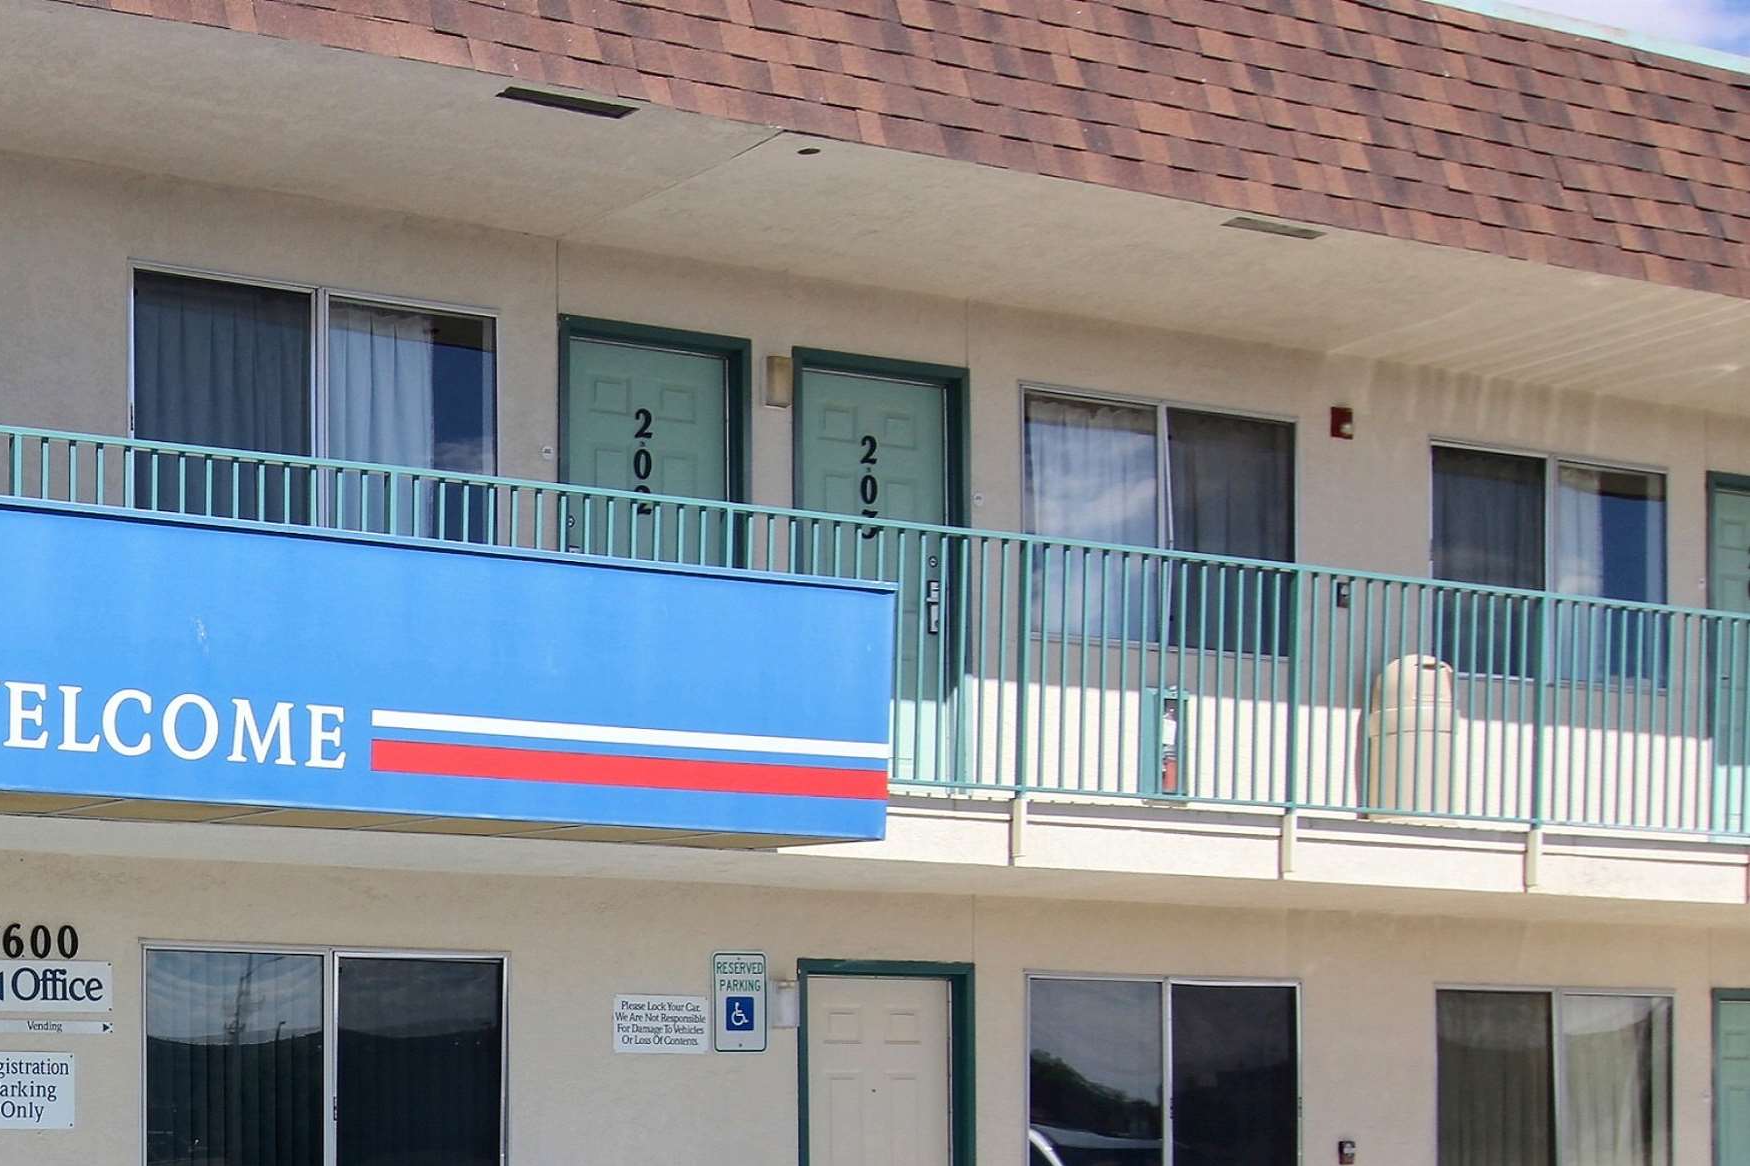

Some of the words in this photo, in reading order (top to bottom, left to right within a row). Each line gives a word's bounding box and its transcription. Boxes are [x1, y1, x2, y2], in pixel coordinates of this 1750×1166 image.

[716, 962, 763, 975] RESERVED
[11, 967, 103, 1002] Office
[719, 979, 761, 992] PARKING
[621, 1001, 646, 1010] Please
[647, 1001, 666, 1011] Lock
[667, 1002, 684, 1011] Your
[615, 1012, 629, 1021] We
[629, 1013, 643, 1021] Are
[645, 1013, 659, 1022] Not
[661, 1014, 706, 1025] Responsible
[27, 1021, 63, 1032] Vending
[617, 1024, 631, 1033] For
[632, 1024, 663, 1035] Damage
[664, 1025, 673, 1034] To
[674, 1025, 704, 1034] Vehicles
[622, 1035, 633, 1044] Or
[634, 1035, 651, 1045] Loss
[653, 1035, 664, 1045] Of
[0, 1101, 44, 1122] Only
